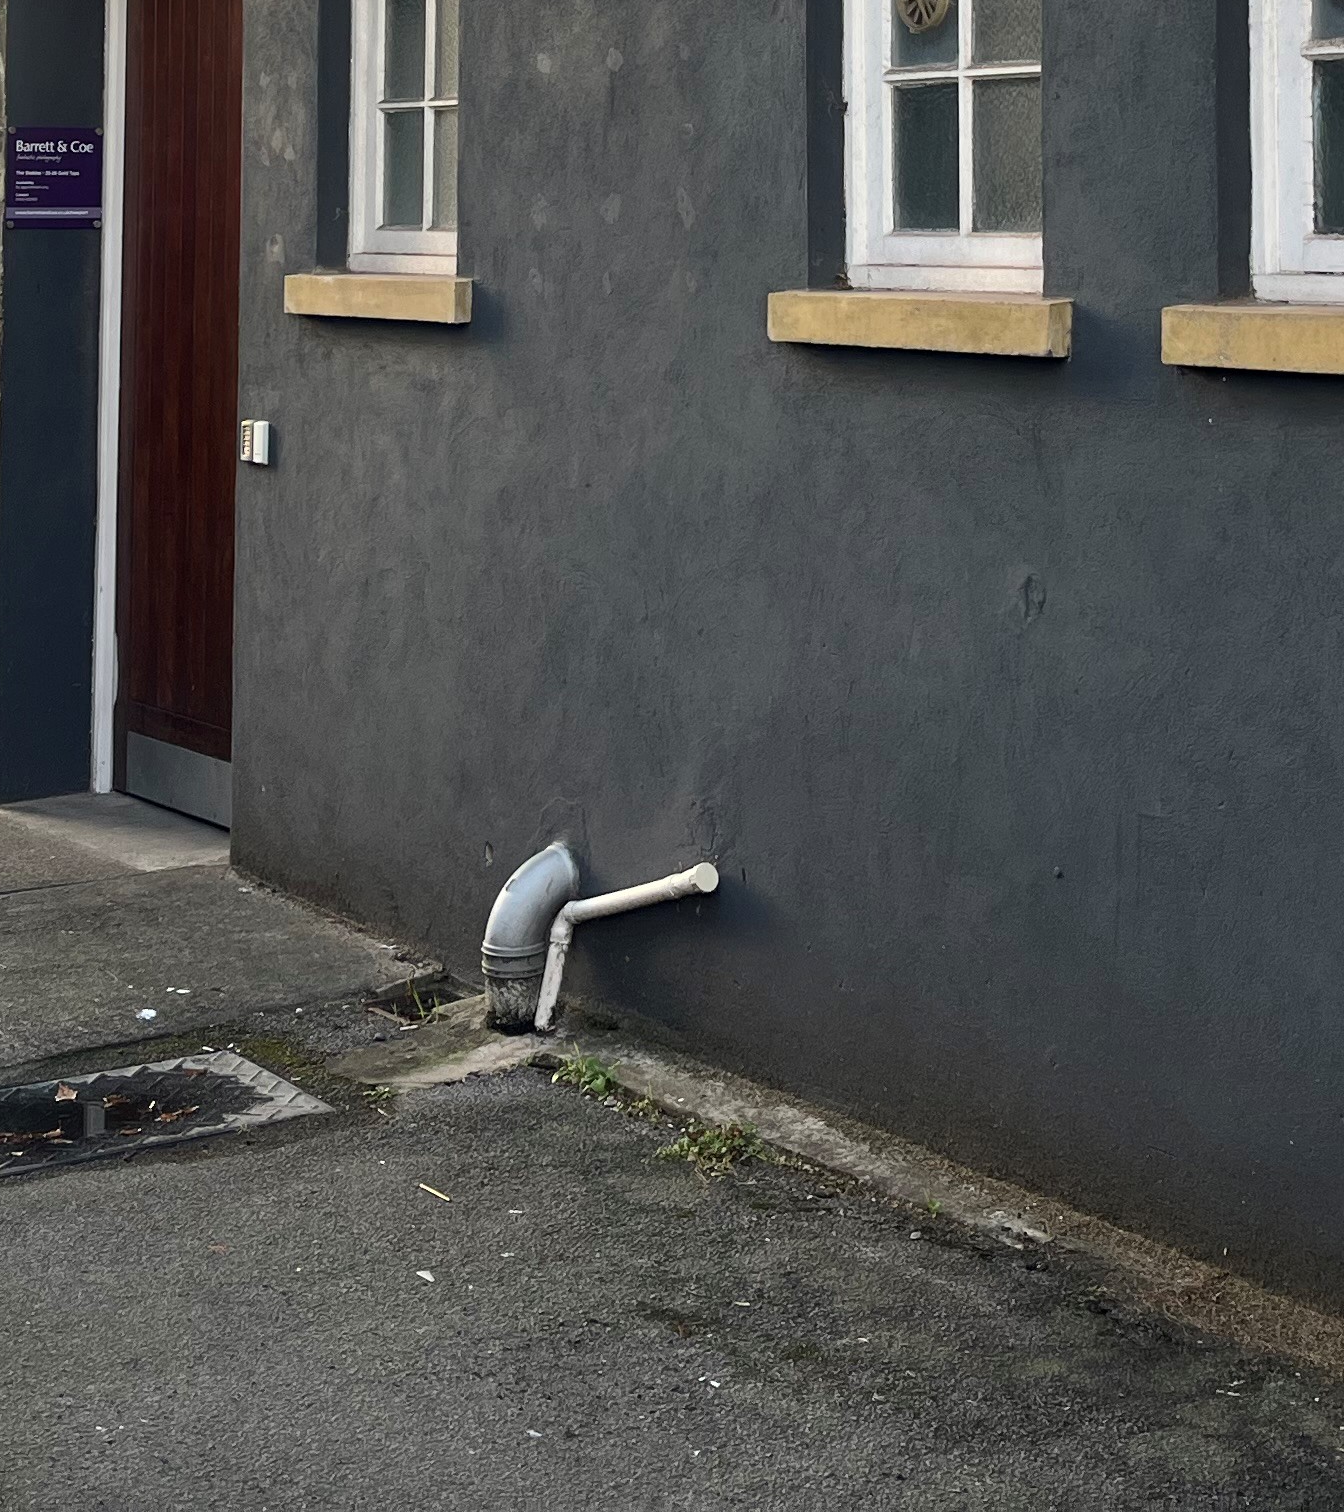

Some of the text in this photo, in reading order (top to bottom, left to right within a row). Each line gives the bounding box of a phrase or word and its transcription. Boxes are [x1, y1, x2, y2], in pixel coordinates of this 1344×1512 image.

[16, 139, 94, 153] Barrett & Coe
